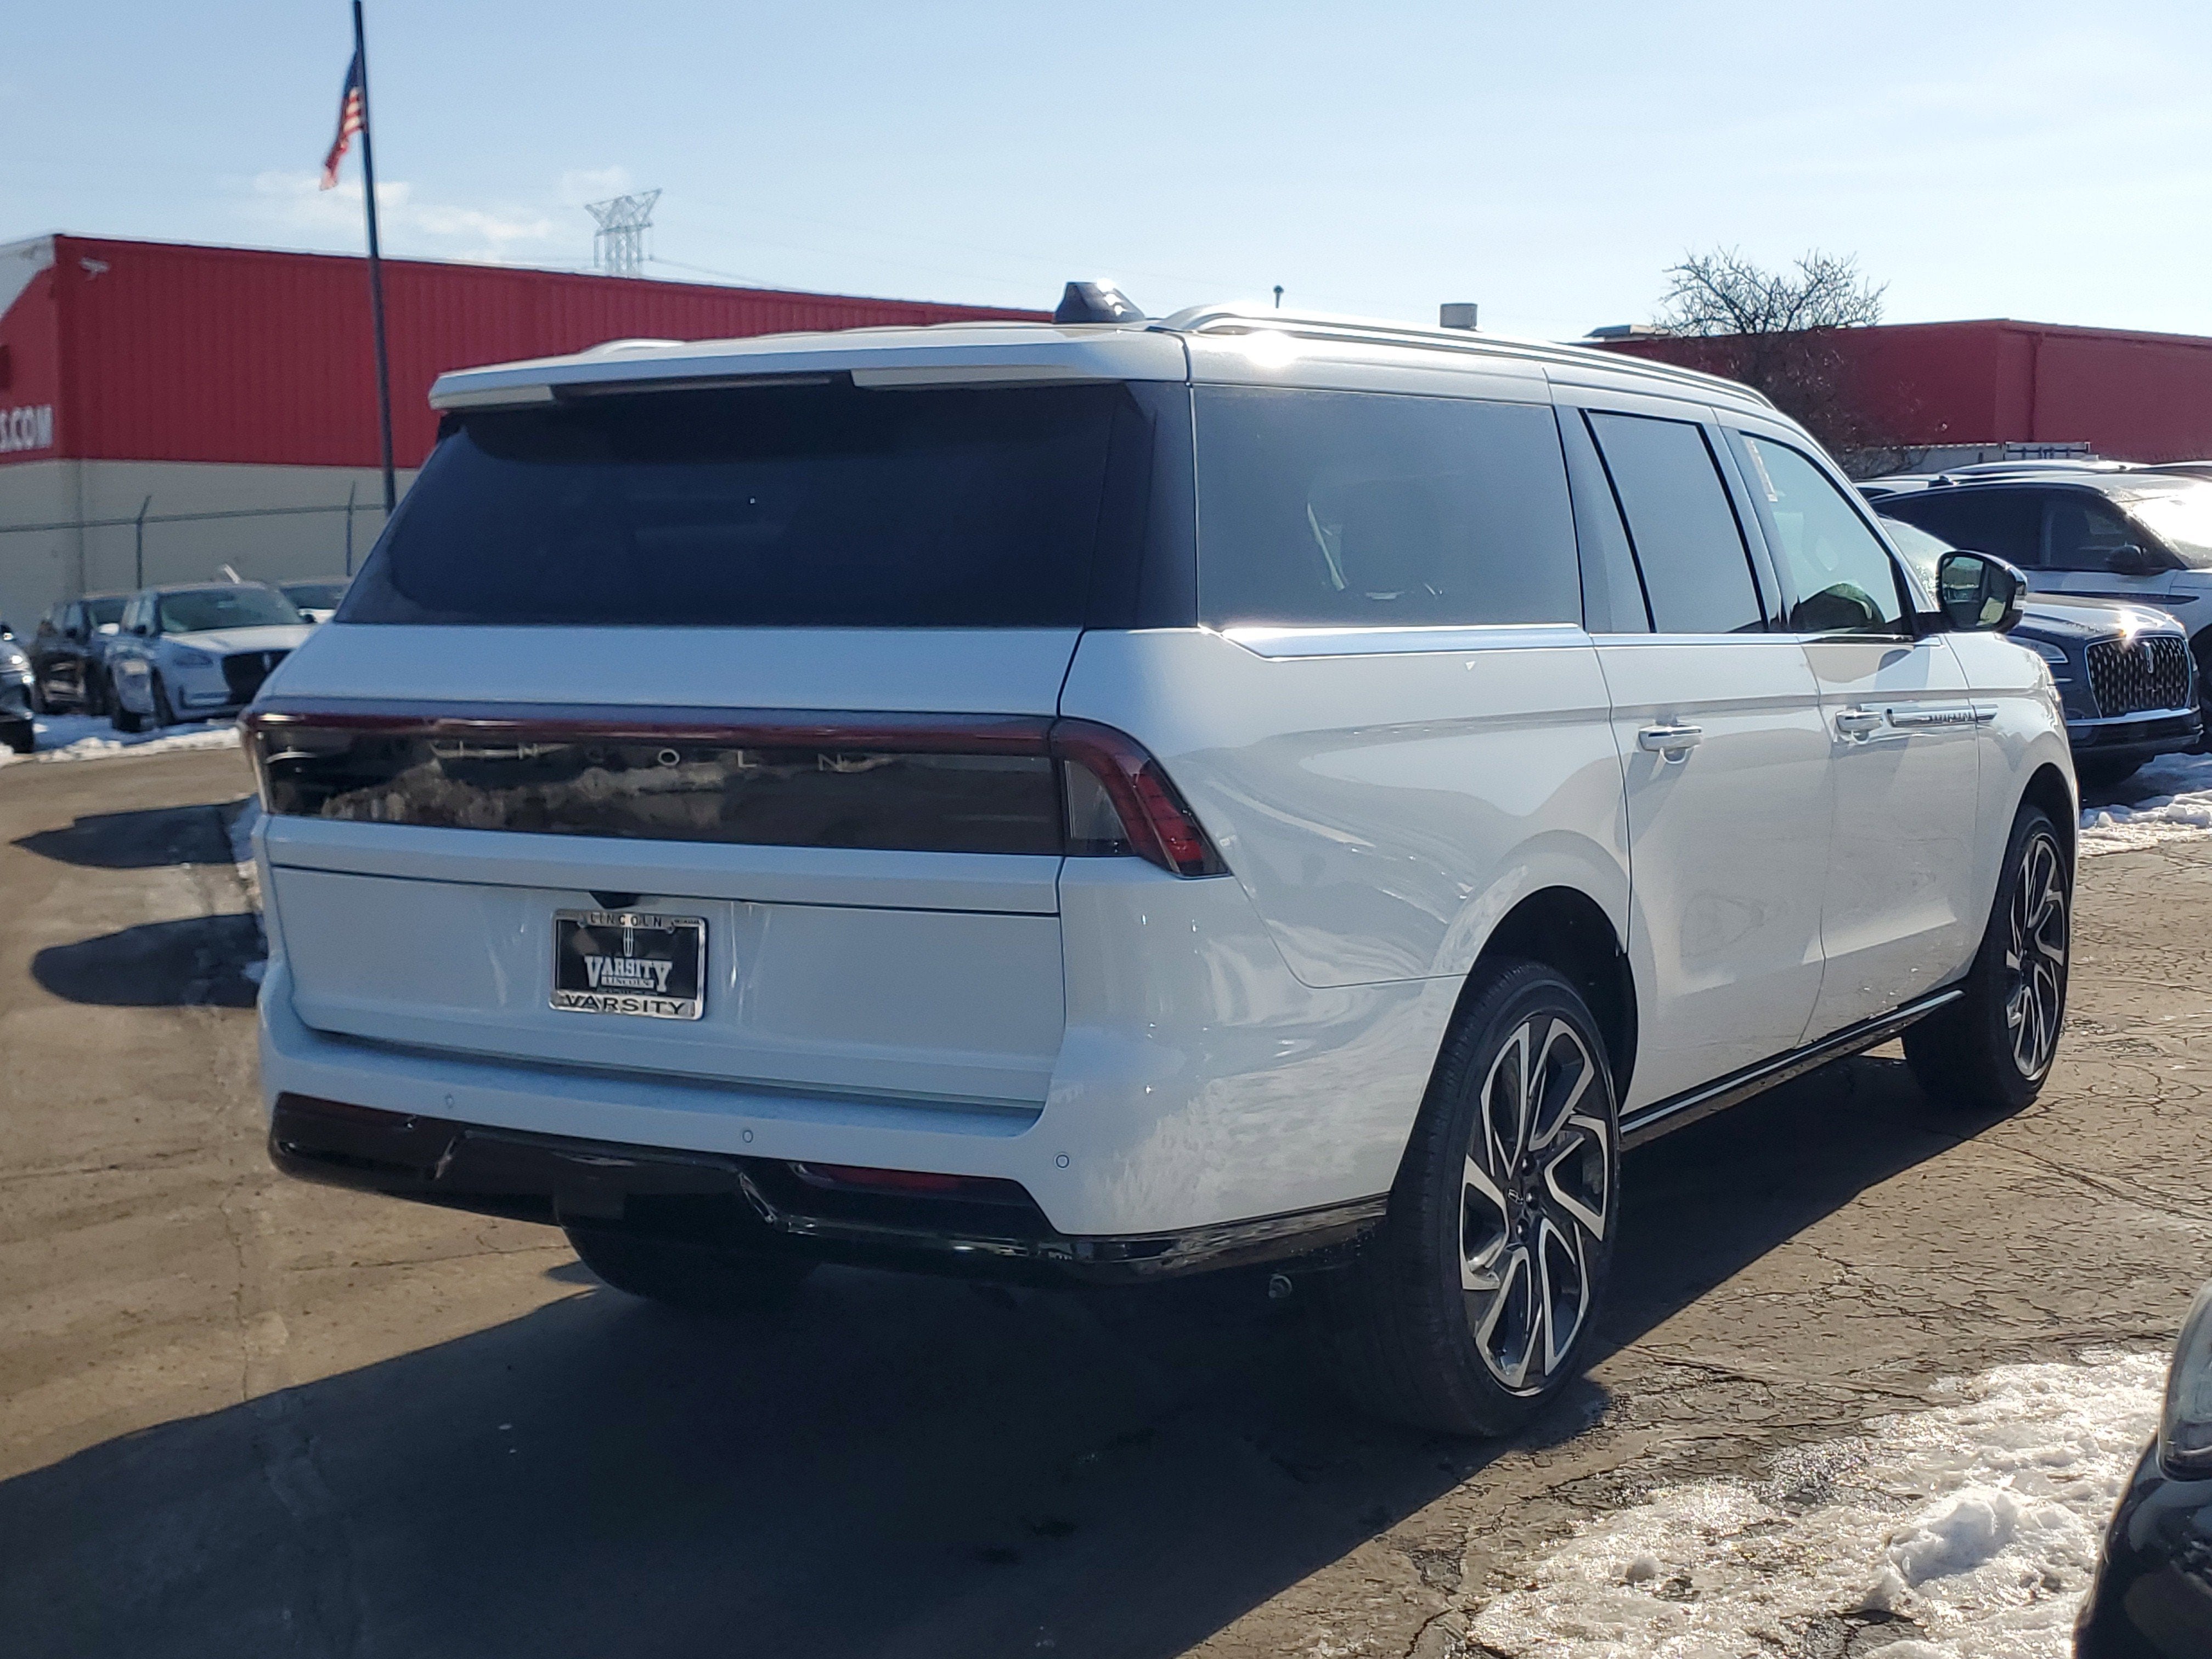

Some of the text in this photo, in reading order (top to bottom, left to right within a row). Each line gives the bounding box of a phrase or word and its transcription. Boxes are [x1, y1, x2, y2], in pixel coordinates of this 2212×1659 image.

[590, 911, 662, 927] LINCOLN
[584, 954, 673, 993] VARSITY
[565, 994, 685, 1015] VARSITY
